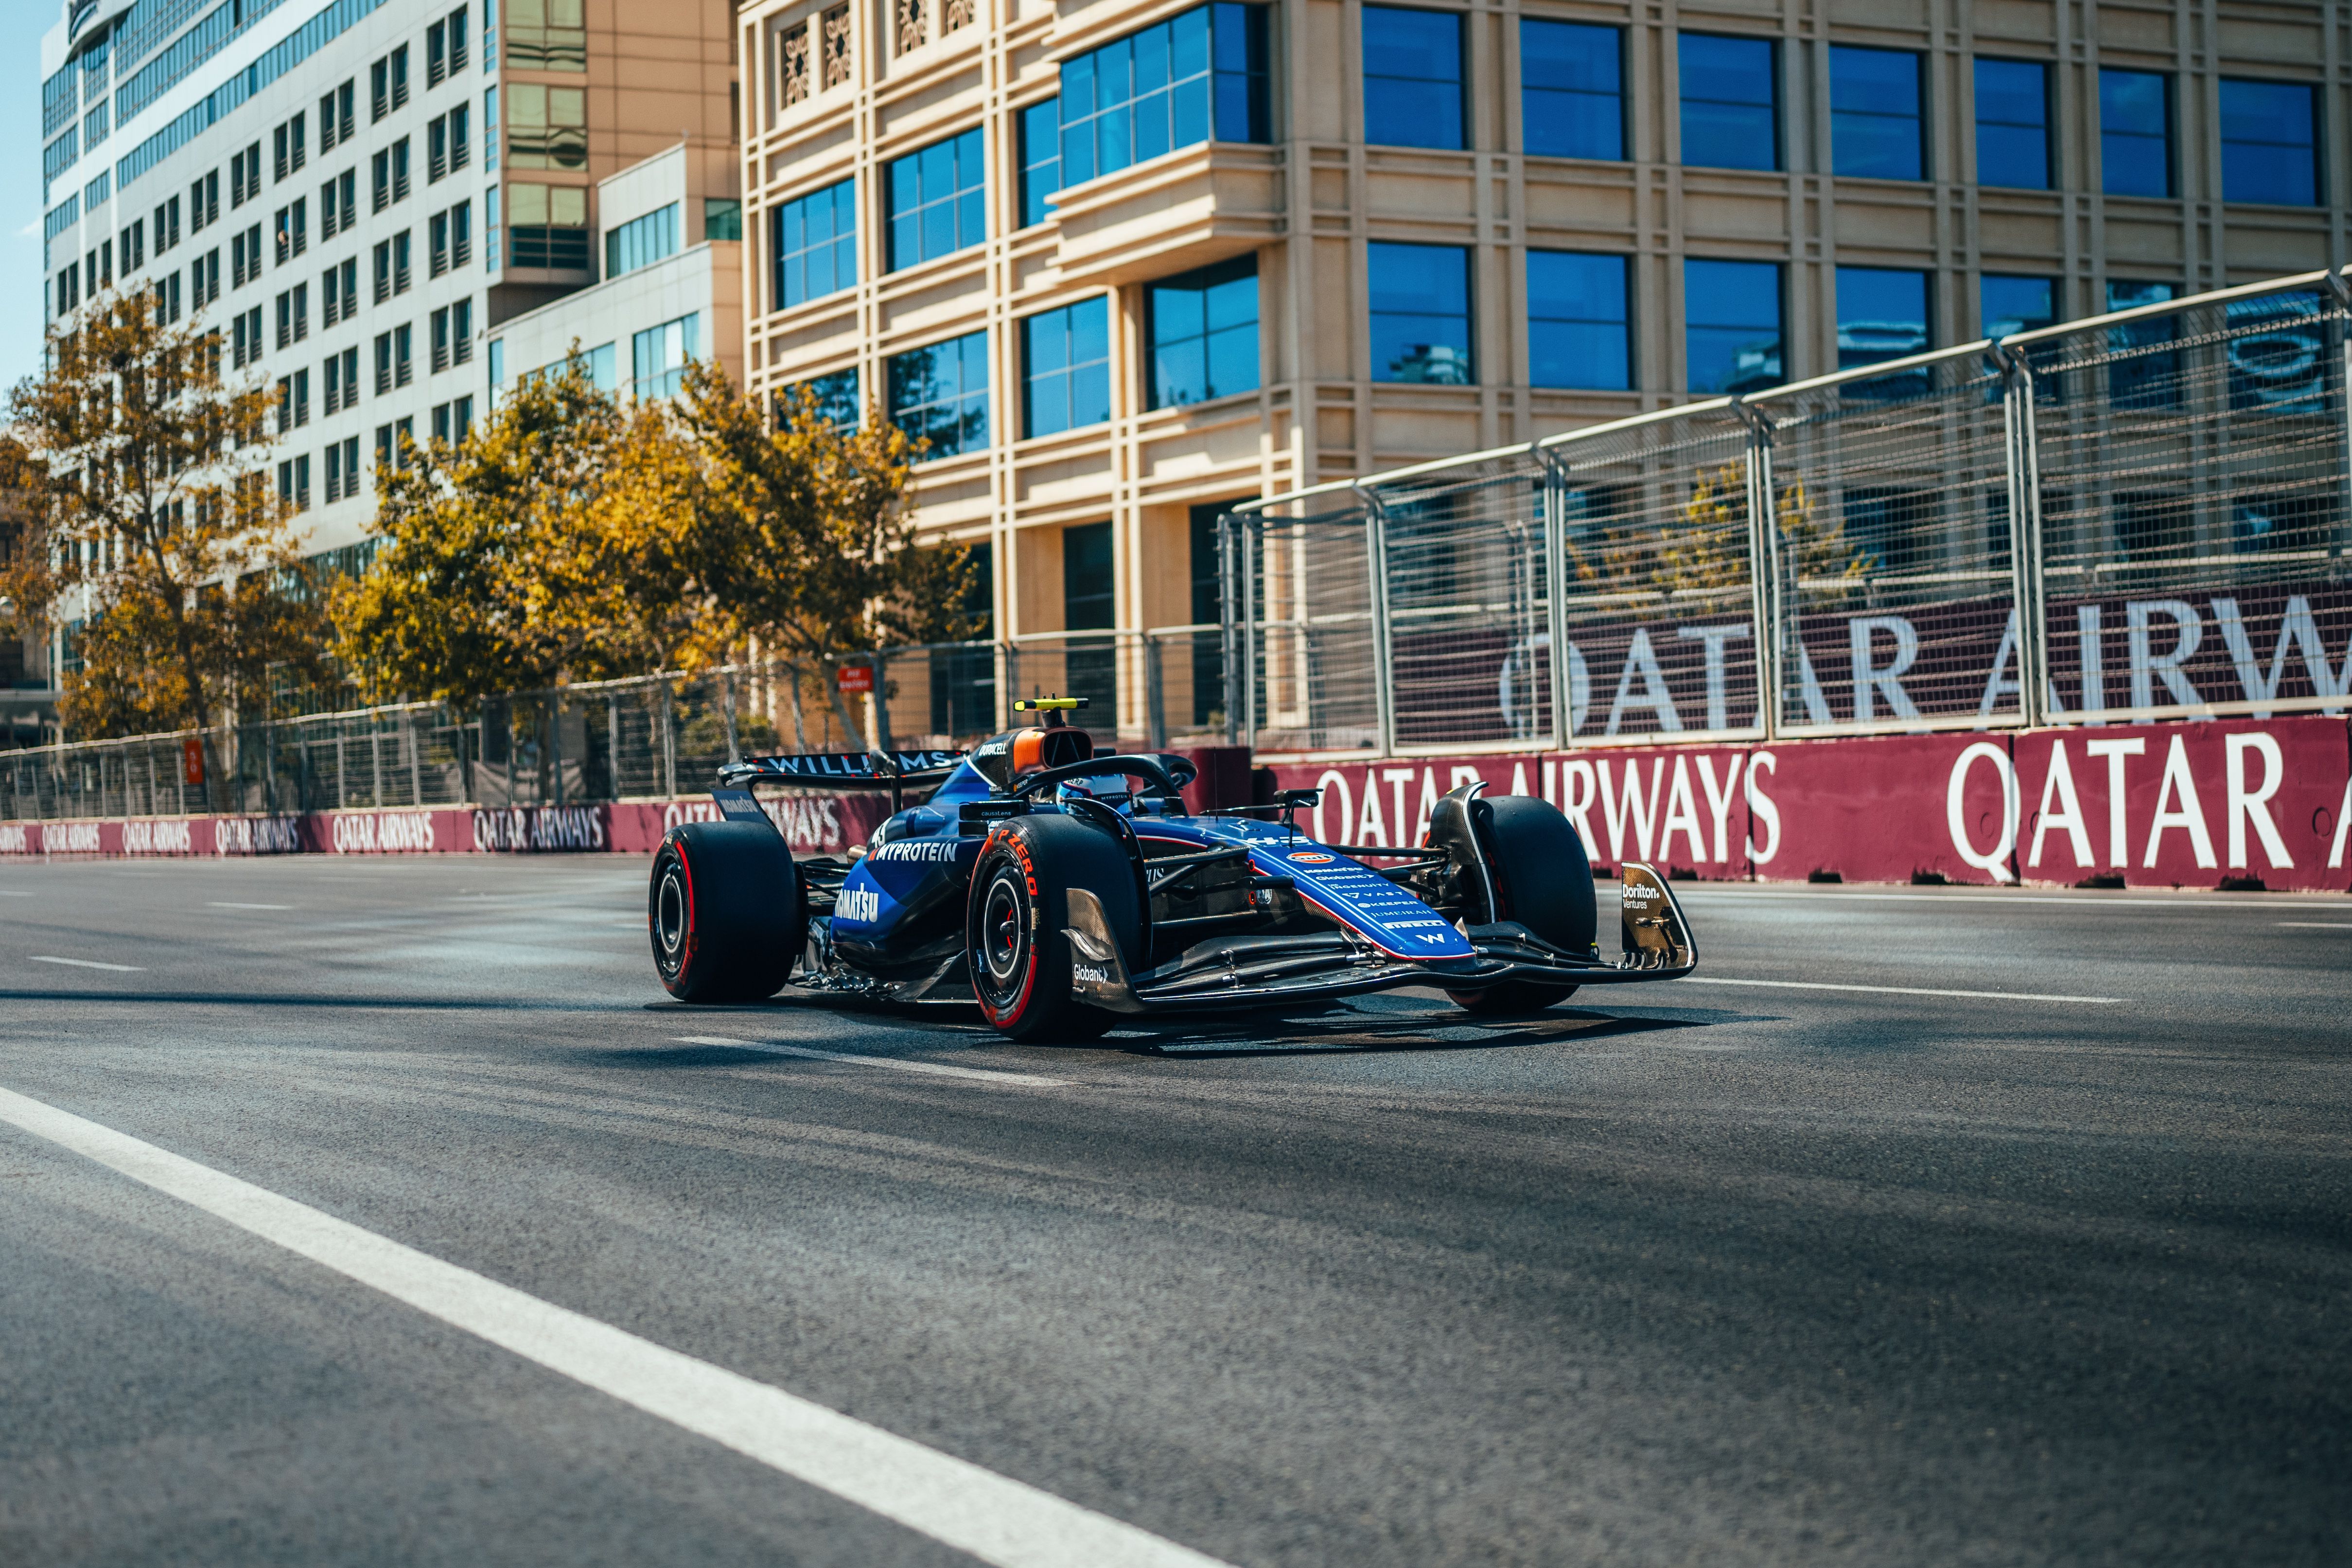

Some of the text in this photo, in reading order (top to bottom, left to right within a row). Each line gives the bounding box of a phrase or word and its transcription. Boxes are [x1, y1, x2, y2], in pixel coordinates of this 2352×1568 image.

[979, 742, 1006, 756] DURACELL
[768, 752, 952, 774] WILLIMS
[1947, 732, 2294, 882] QATAR
[333, 812, 435, 854] QATAR AIRWAYS
[474, 806, 603, 852] QATAR AIRWAYS
[876, 842, 958, 862] MYPROTEIN
[998, 829, 1038, 896] P ZERO
[1623, 899, 1647, 909] Ventures
[1383, 920, 1447, 929] PIRELLI
[1074, 964, 1103, 982] Globant
